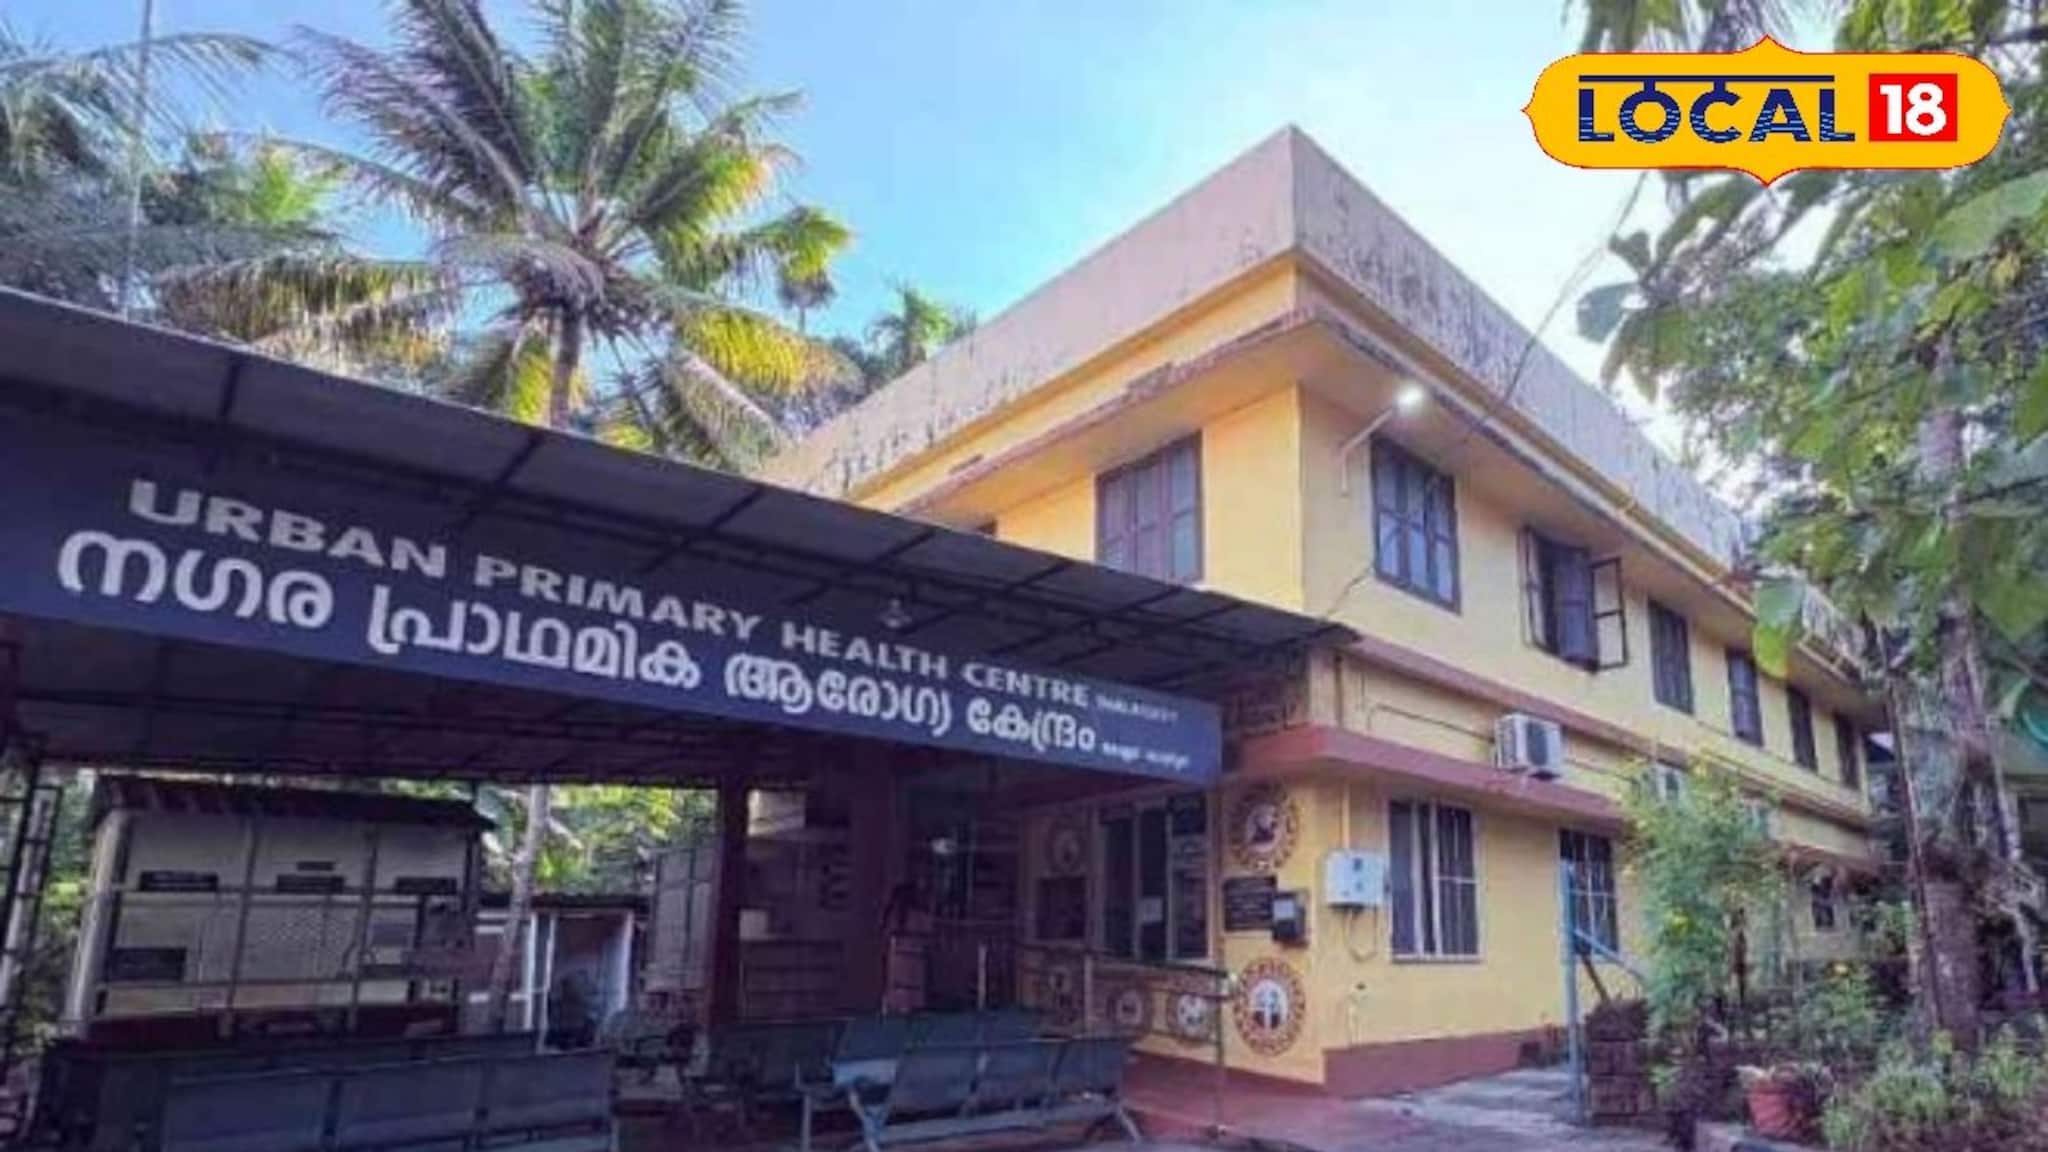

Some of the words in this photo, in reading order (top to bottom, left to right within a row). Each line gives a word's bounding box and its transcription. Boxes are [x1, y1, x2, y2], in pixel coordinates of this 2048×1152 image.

[57, 529, 334, 629] നഗര
[366, 583, 701, 690] പ്രാഥമിക
[725, 652, 952, 737] ആരോഗ്യ
[966, 699, 1096, 752] കേന്ദ്രം
[130, 479, 447, 578] URBAN
[474, 554, 761, 641] PRIMARY
[780, 621, 949, 680] HEALTH
[962, 661, 1088, 708] CENTRE
